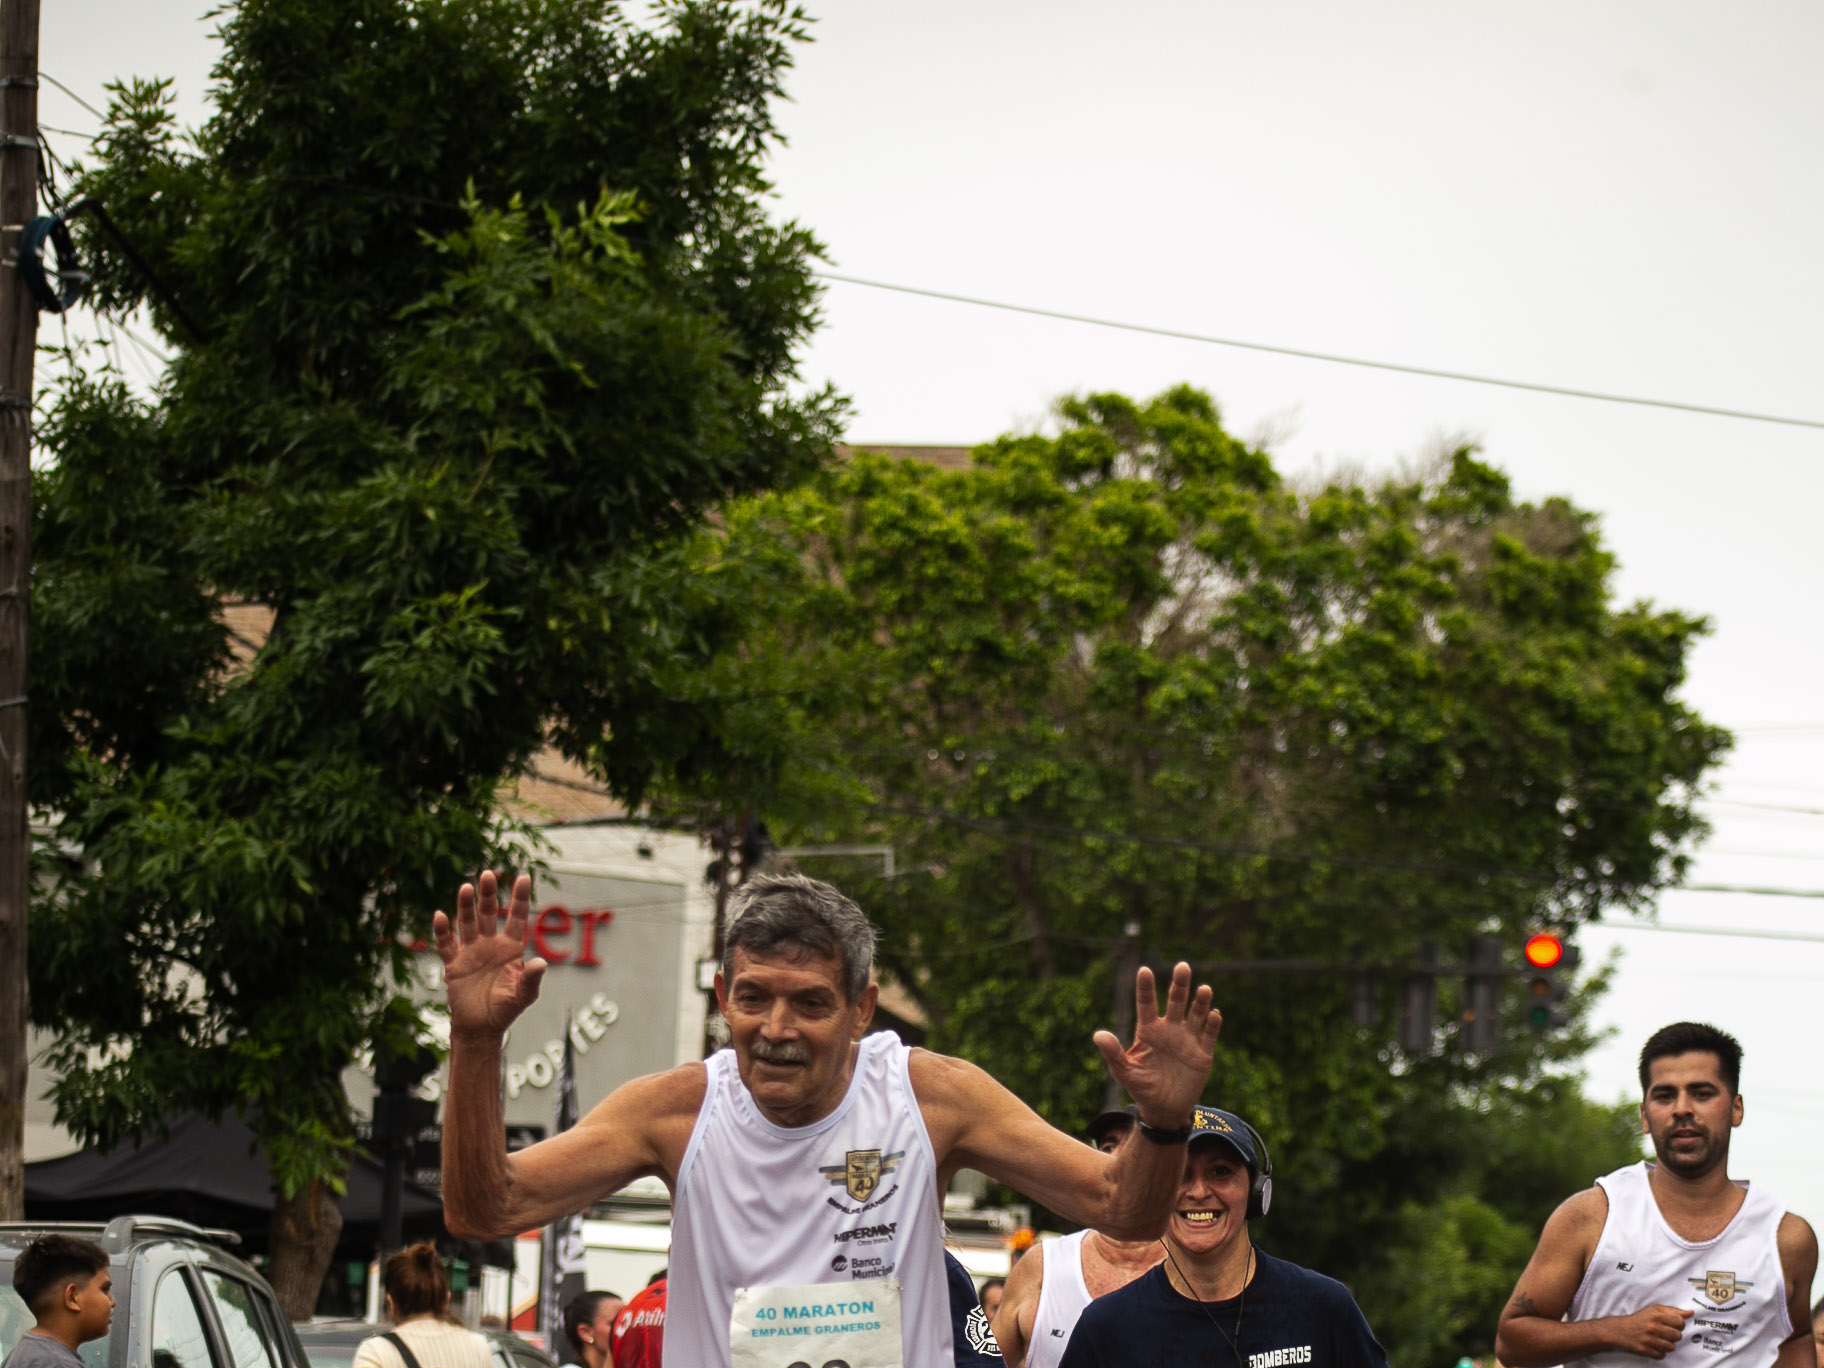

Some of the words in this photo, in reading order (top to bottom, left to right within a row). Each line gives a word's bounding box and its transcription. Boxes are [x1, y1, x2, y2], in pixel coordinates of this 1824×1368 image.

[852, 1257, 882, 1269] Banco
[1711, 1289, 1729, 1299] 40
[755, 1307, 777, 1320] 40
[783, 1301, 875, 1320] MARATON
[751, 1326, 811, 1337] EMPALME
[815, 1321, 881, 1335] GRANEROS
